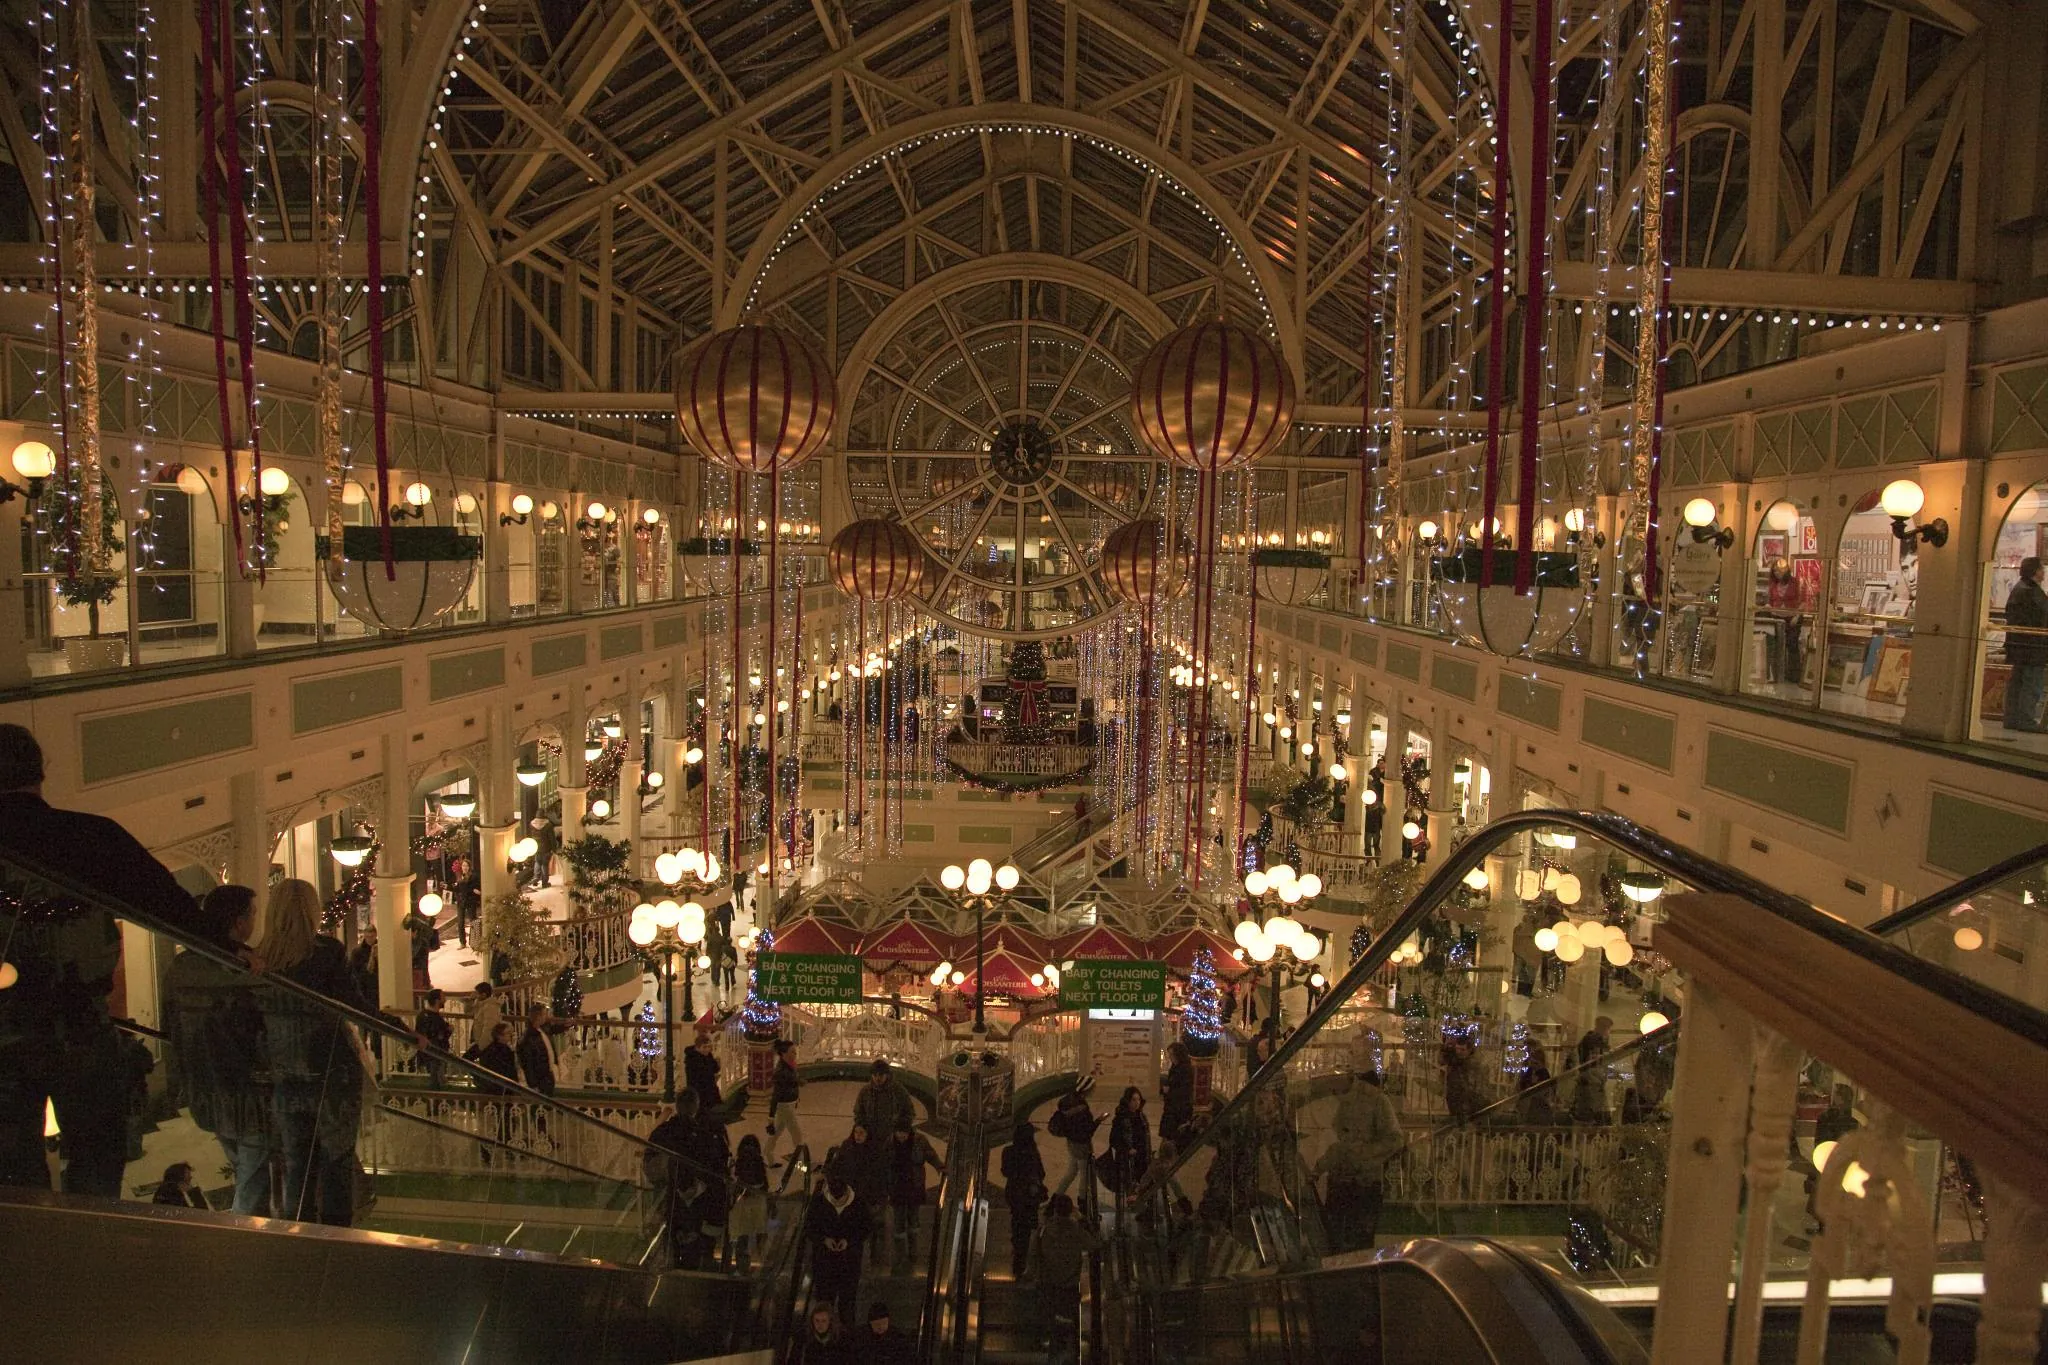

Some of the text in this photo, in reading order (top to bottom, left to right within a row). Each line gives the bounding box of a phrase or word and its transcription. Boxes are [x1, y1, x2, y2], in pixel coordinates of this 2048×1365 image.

[762, 962, 856, 974] BABY CHANGING
[1065, 968, 1160, 980] BABY CHANGING
[780, 974, 838, 985] & TOILETS
[971, 977, 1028, 989] COISSANTERIE
[1082, 980, 1142, 991] & TOILETS
[763, 985, 855, 998] NEXT FLOOR UP
[1065, 992, 1158, 1003] NEXT FLOOR UP
